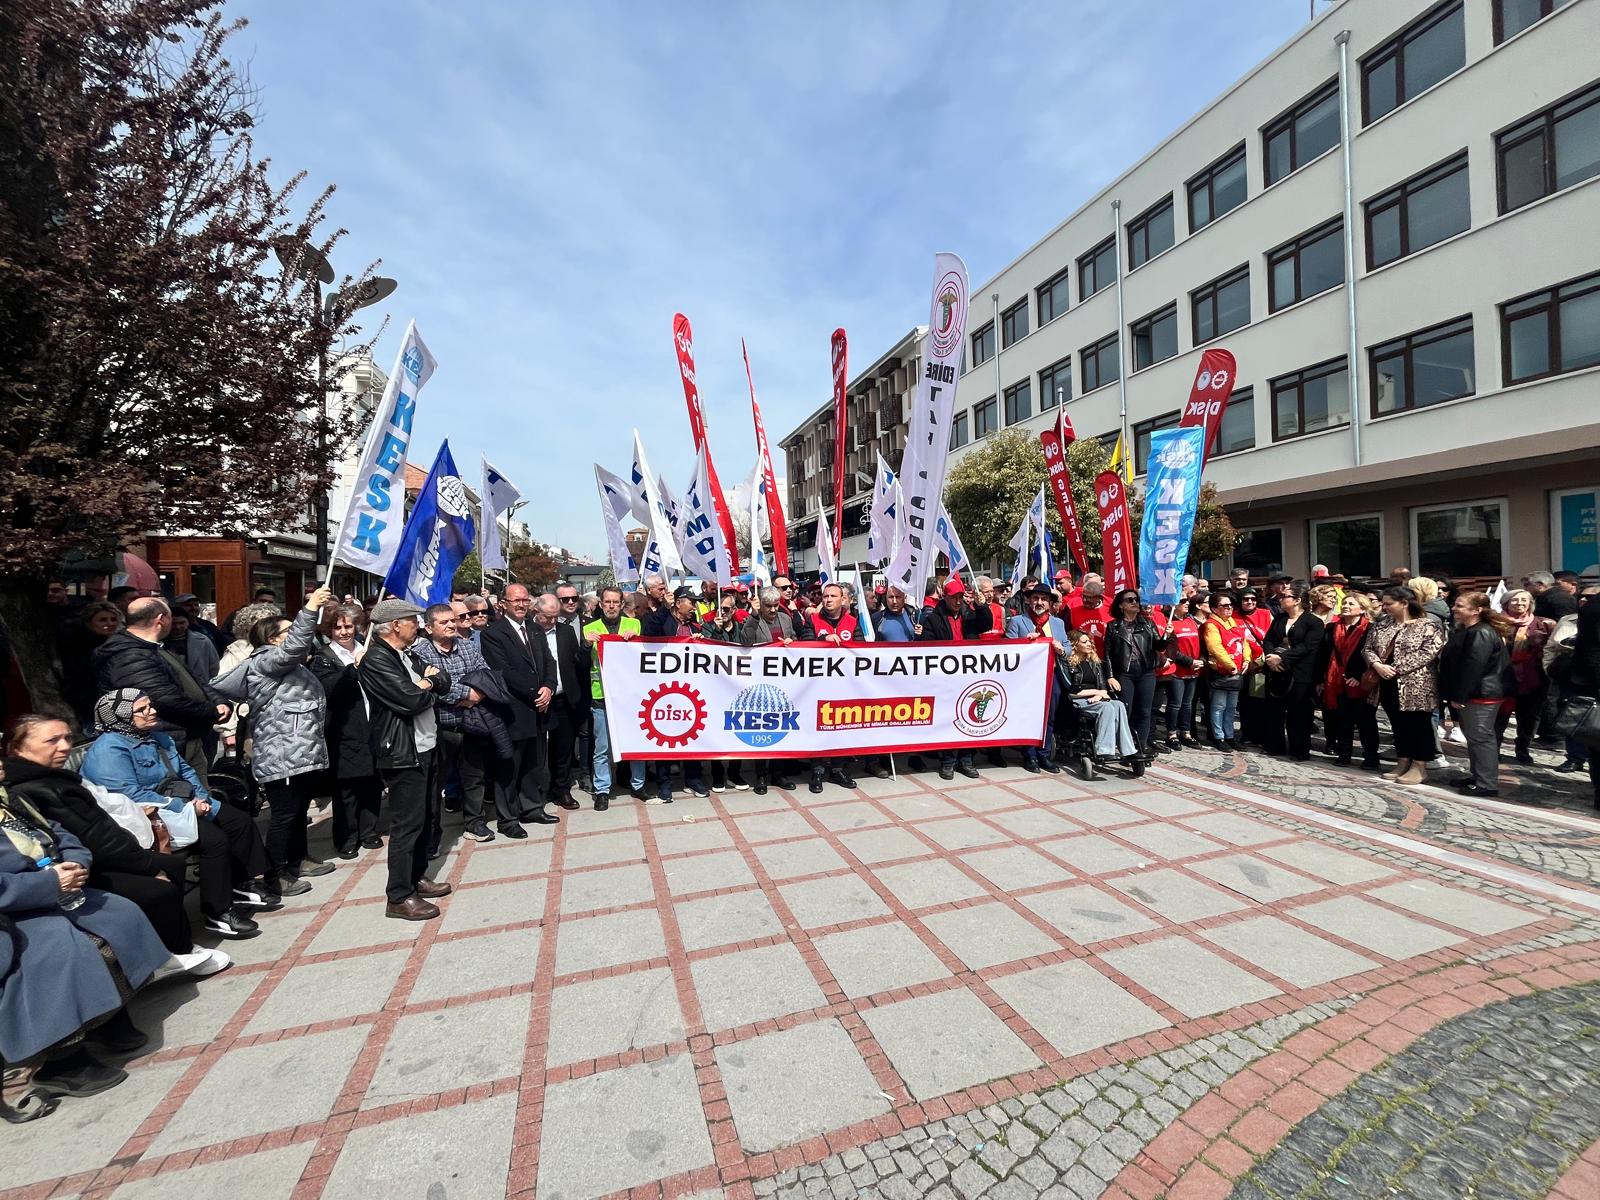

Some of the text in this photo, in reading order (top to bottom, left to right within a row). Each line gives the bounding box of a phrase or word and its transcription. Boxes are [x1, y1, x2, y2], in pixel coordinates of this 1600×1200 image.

[351, 391, 417, 556] KESK
[639, 646, 1021, 678] EDİRNE EMEK PLATFORMU
[654, 704, 693, 721] DİSK
[723, 710, 800, 730] KESK
[820, 698, 931, 725] tmmob
[751, 734, 772, 744] 1995
